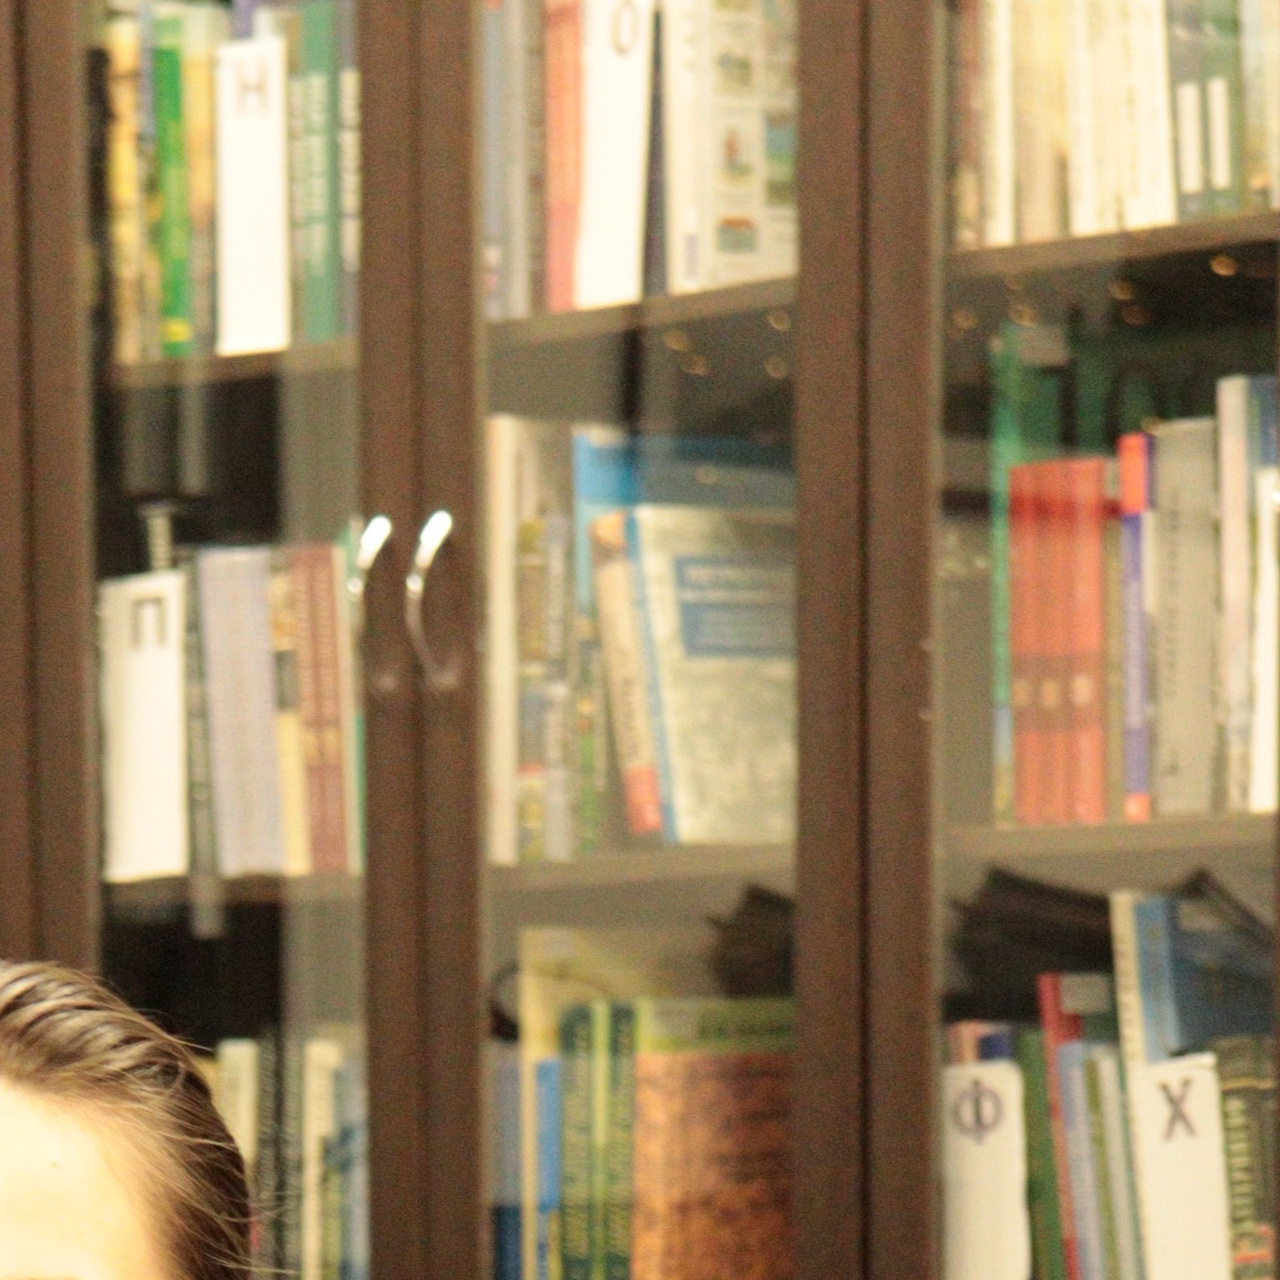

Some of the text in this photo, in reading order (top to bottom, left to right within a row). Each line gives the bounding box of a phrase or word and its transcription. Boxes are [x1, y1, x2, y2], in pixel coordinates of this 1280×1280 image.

[233, 59, 272, 119] Н
[130, 596, 167, 648] П
[951, 1078, 1005, 1144] Ф
[1159, 1077, 1198, 1141] Х
